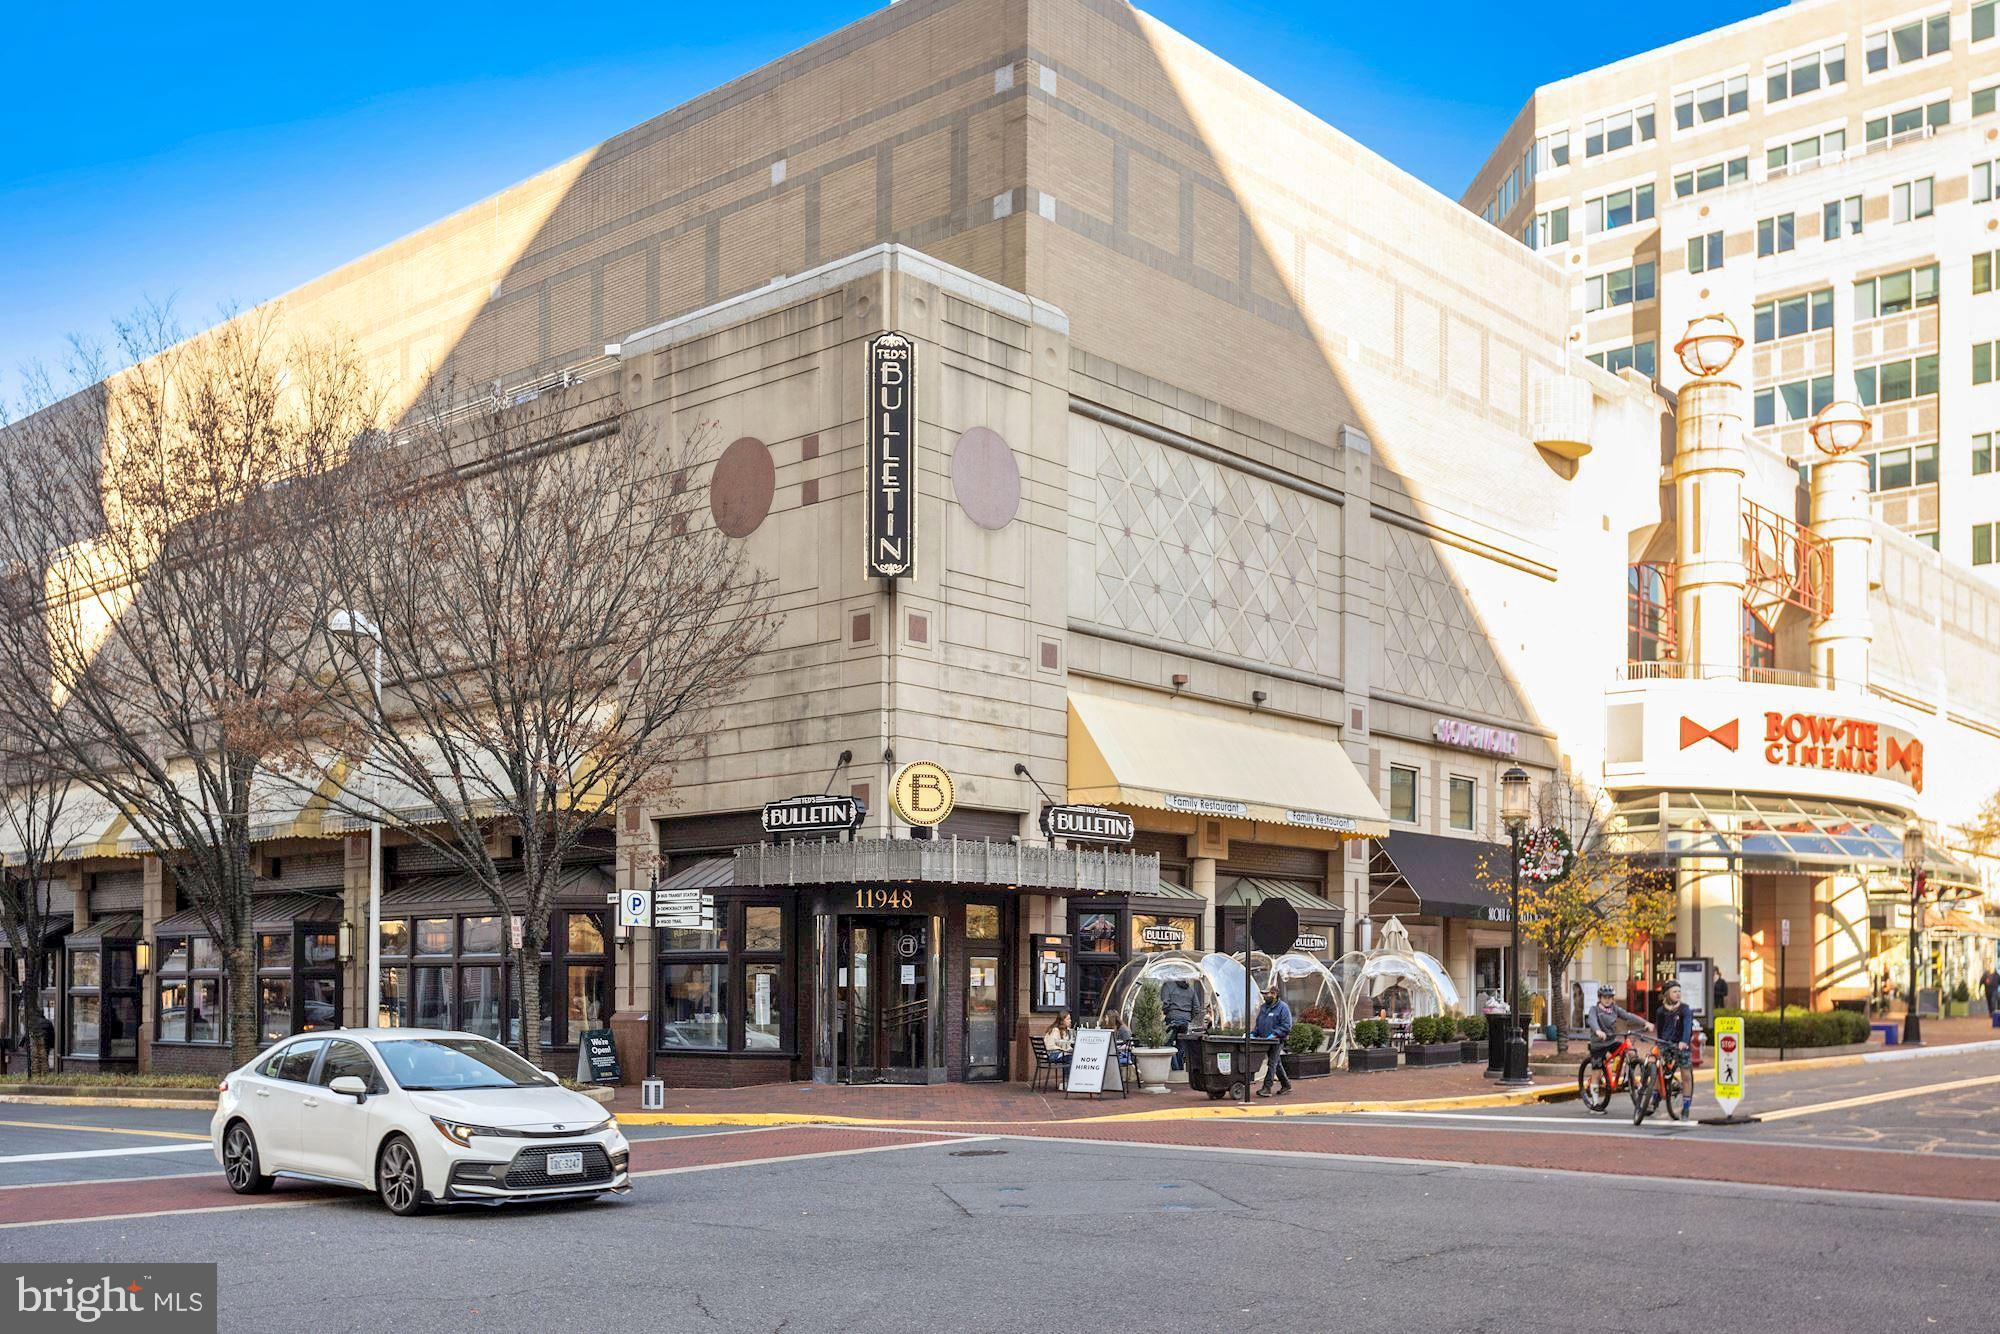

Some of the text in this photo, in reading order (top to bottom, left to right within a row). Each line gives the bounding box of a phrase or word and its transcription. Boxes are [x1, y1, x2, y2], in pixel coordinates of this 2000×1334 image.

[877, 349, 907, 360] TED'S
[880, 361, 903, 561] BULLETIN
[1764, 743, 1879, 775] CINEMAS
[908, 773, 945, 812] B
[1173, 795, 1240, 813] Family Restaurant
[770, 804, 847, 827] BULLETIN
[1292, 811, 1350, 828] Family Restaurant
[1057, 813, 1127, 836] BULLETIN
[632, 897, 642, 911] P
[856, 888, 913, 908] 11948
[1146, 930, 1181, 941] BULLETIN
[1295, 937, 1325, 947] BULLETIN
[590, 1037, 609, 1046] We're
[591, 1045, 612, 1055] Open!
[1721, 1040, 1736, 1048] STOP
